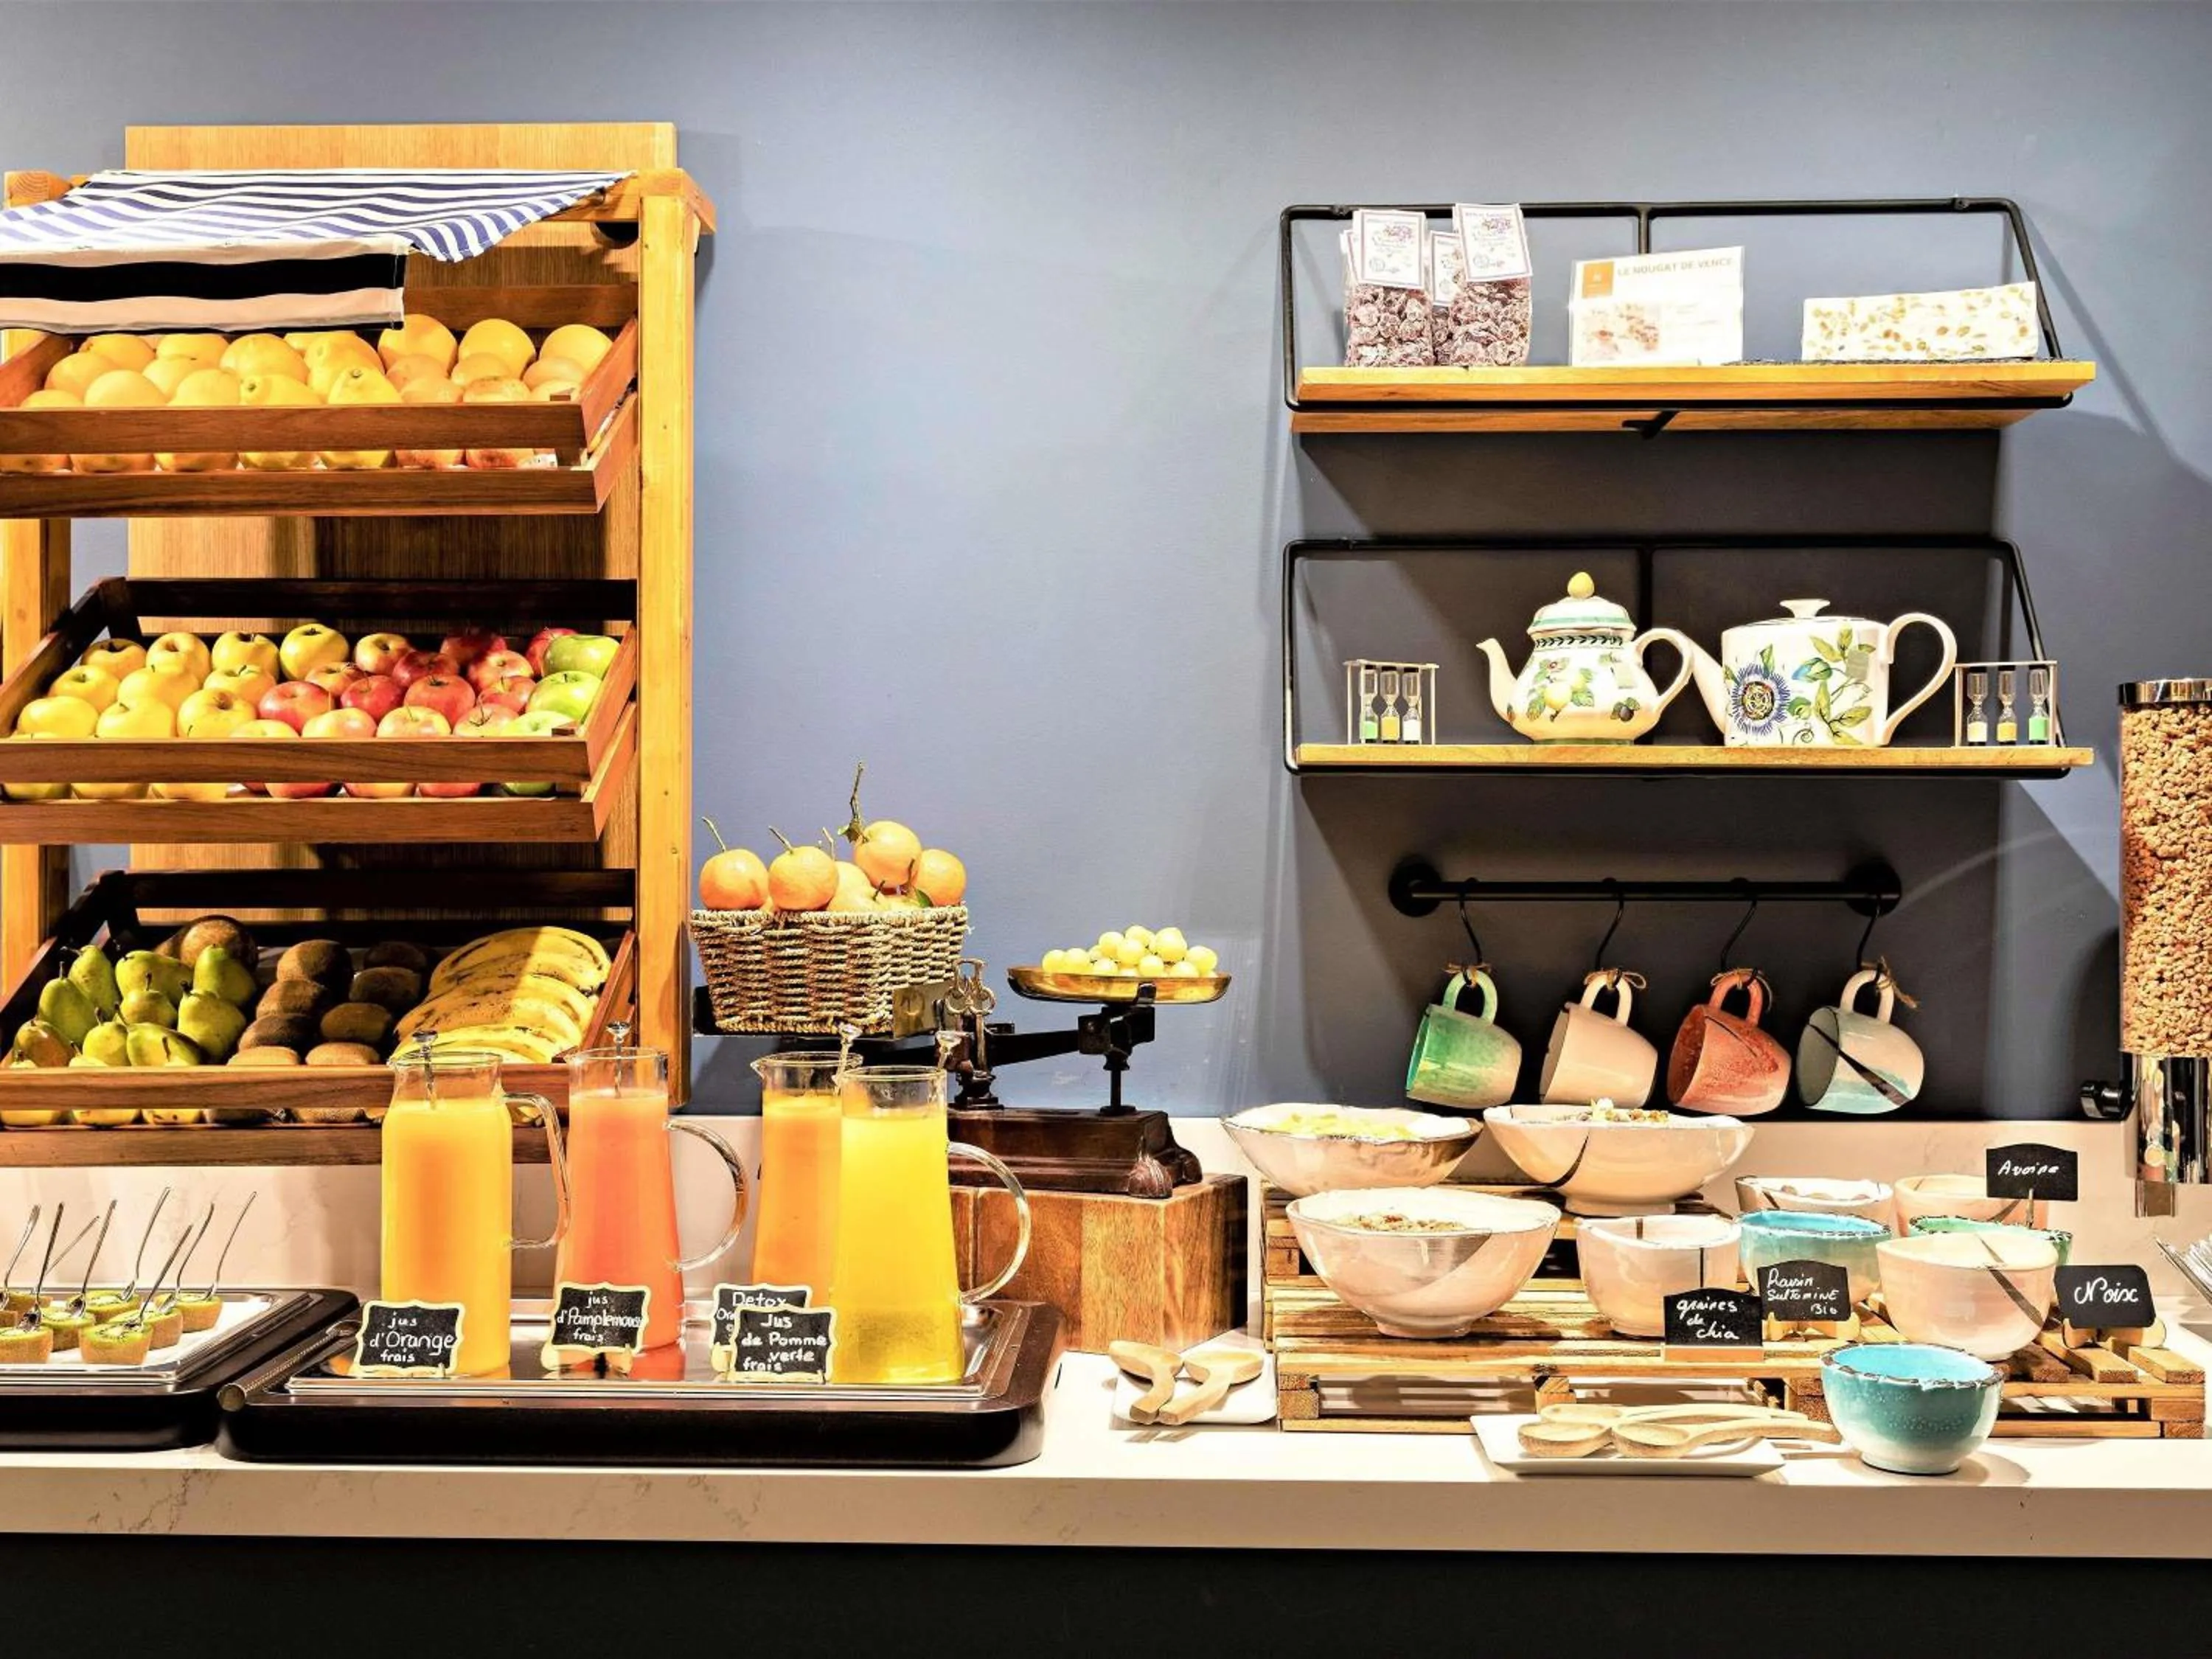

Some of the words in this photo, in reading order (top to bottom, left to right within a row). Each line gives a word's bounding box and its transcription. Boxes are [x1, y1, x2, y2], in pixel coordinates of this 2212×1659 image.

[1618, 267, 1630, 276] LE
[1633, 263, 1676, 274] NOUGAT
[1680, 261, 1693, 270] DE
[1698, 257, 1733, 268] VENCE
[1767, 1267, 1814, 1289] Raisin
[585, 1291, 608, 1309] jus
[733, 1292, 787, 1307] Detox
[2073, 1278, 2139, 1304] Noix
[1676, 1295, 1738, 1321] graines
[387, 1311, 417, 1329] jus
[1686, 1313, 1706, 1326] de
[574, 1327, 604, 1343] frais
[741, 1332, 763, 1346] de
[769, 1332, 827, 1346] Pomme
[1696, 1321, 1740, 1340] chia
[369, 1331, 455, 1355] d'Orange
[380, 1347, 415, 1363] frais
[743, 1356, 782, 1371] frais
[770, 1348, 815, 1362] verte
